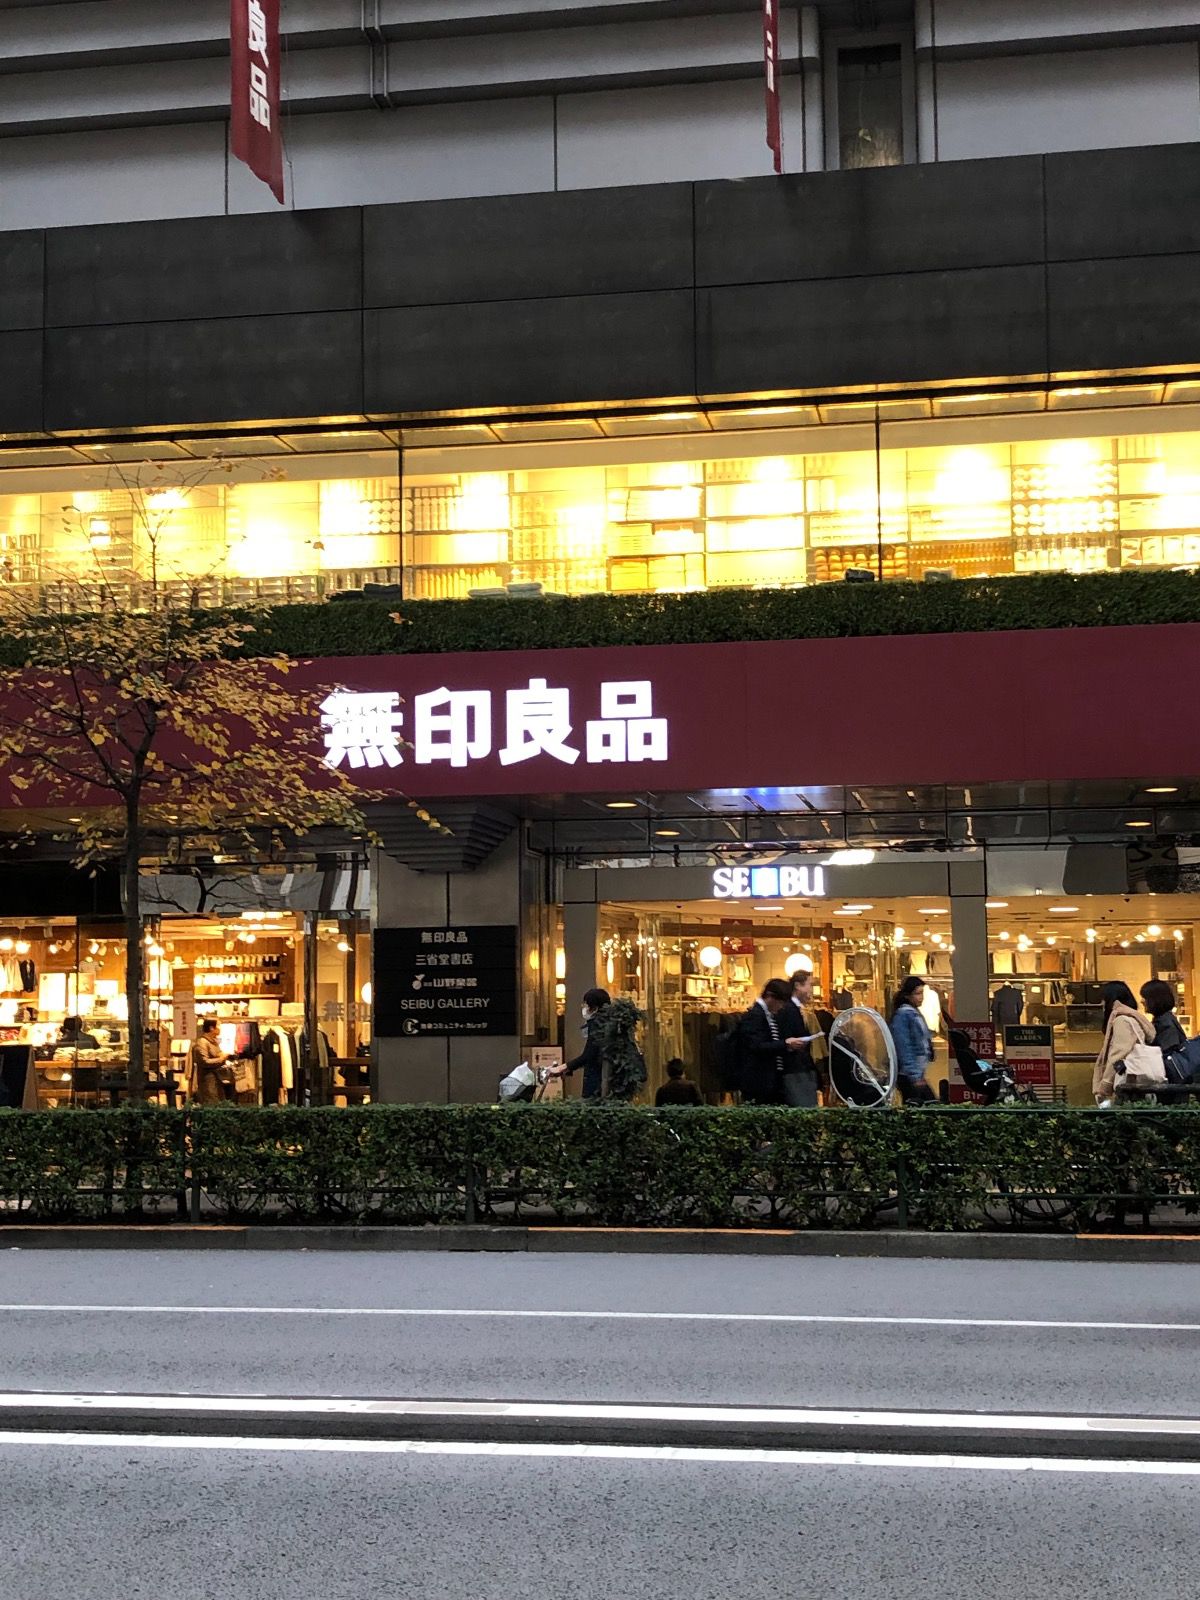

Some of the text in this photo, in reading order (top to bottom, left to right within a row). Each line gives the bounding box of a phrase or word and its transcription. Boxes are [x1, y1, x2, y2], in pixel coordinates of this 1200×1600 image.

[319, 678, 668, 769] 無印良品
[421, 931, 468, 944] 無印良品
[415, 953, 473, 966] 三省堂書店
[400, 998, 490, 1010] SEIBU GALLERY
[952, 1027, 992, 1040] 省堂
